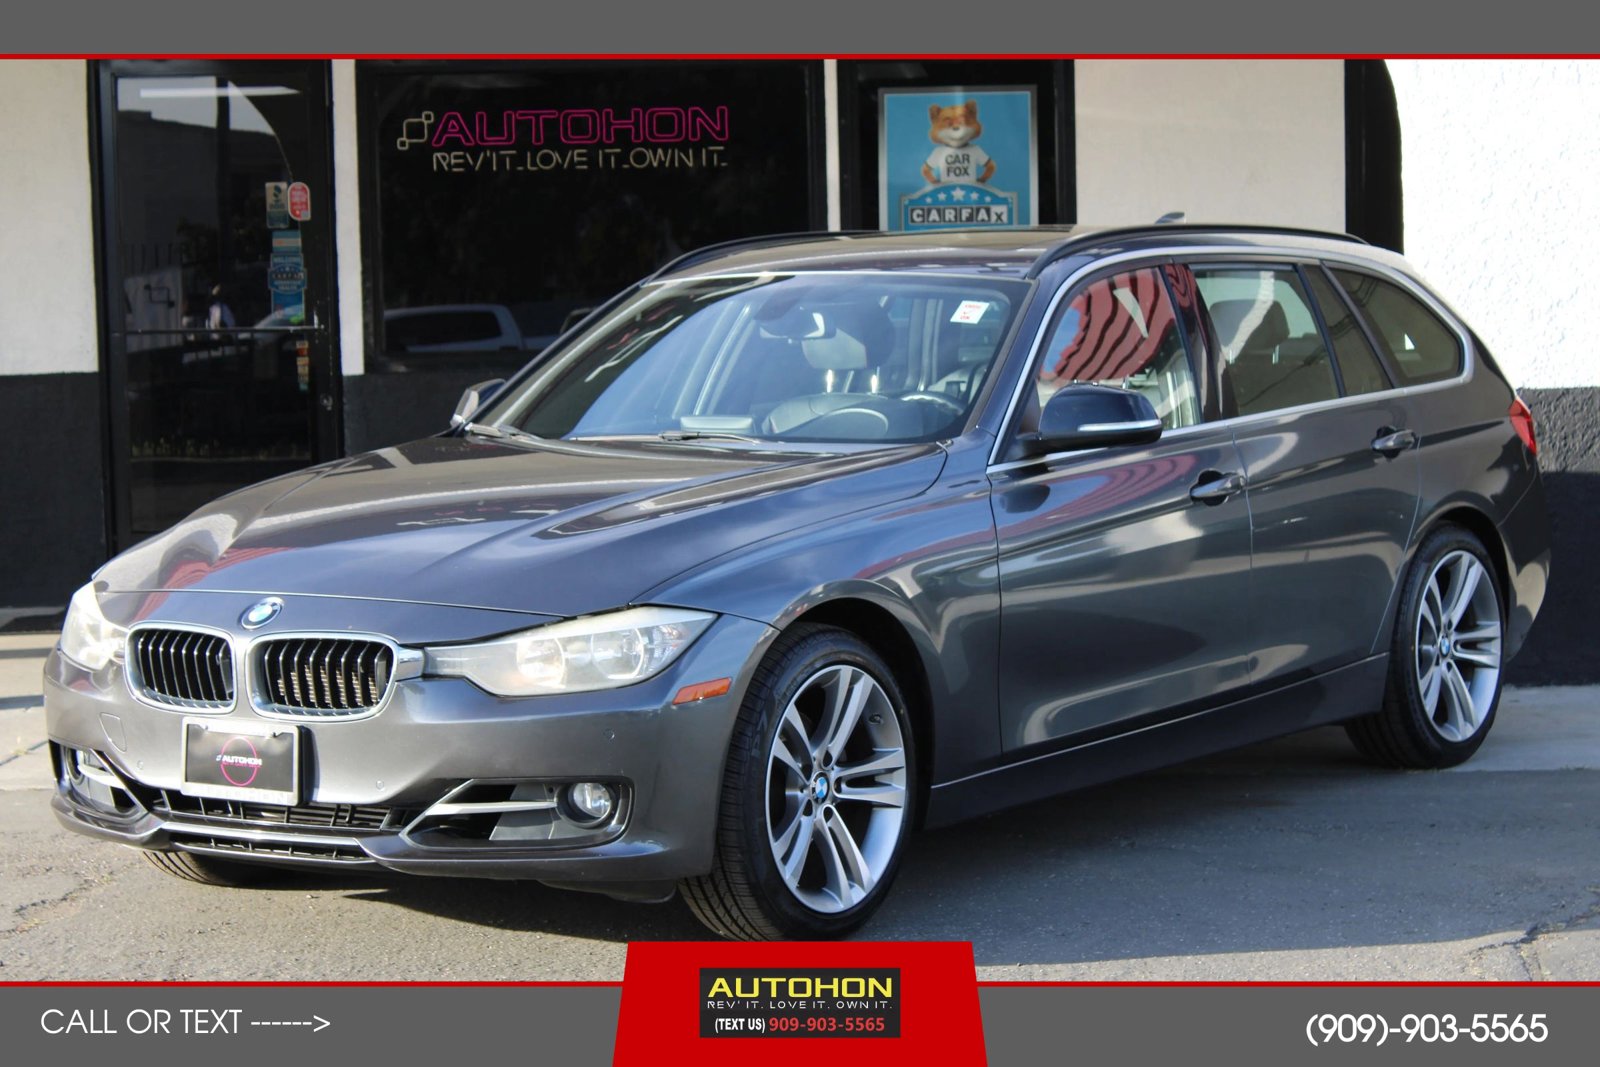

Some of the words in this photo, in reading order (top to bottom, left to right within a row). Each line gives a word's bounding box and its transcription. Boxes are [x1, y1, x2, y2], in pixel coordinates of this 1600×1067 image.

[432, 106, 728, 147] AUTOHON
[527, 149, 588, 170] LOVE
[629, 147, 694, 168] OWN
[945, 153, 970, 165] CAR
[946, 166, 970, 178] FOX
[911, 207, 1004, 222] CARFAX
